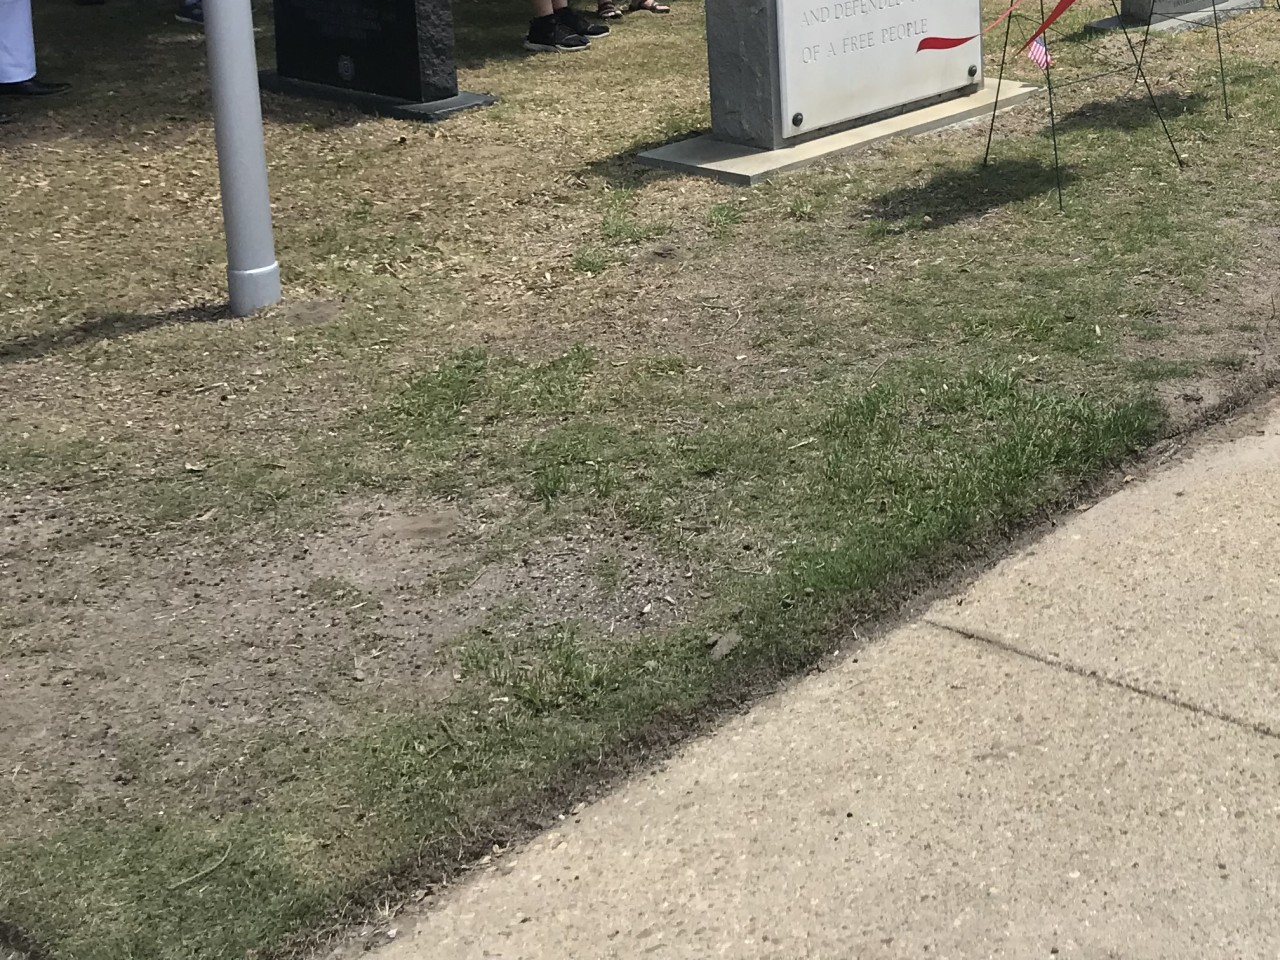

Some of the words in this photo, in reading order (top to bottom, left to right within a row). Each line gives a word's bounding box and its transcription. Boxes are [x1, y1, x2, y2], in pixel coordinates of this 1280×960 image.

[801, 6, 830, 27] AND
[801, 45, 820, 64] OF
[826, 43, 837, 57] A
[842, 31, 875, 53] FREE
[881, 18, 929, 43] PEOPLE
